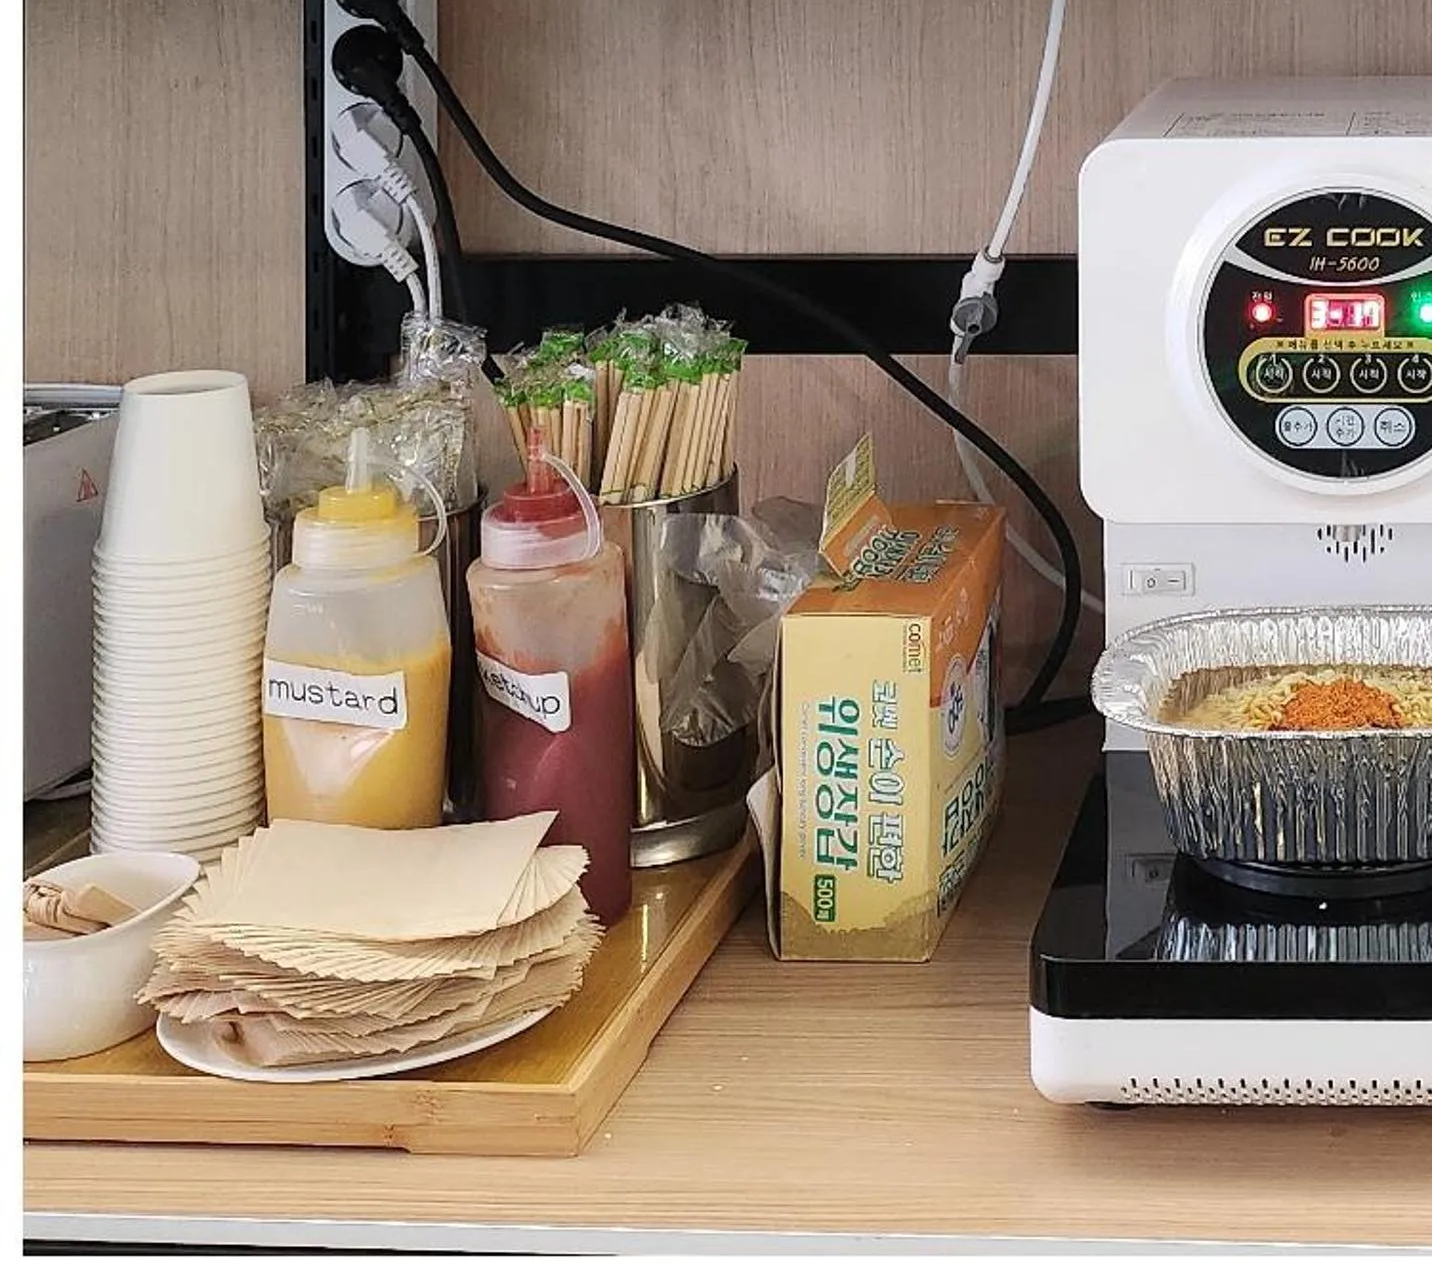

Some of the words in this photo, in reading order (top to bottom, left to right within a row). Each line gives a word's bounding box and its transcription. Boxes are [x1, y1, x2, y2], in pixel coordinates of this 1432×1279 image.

[1264, 228, 1313, 247] EZ
[1326, 228, 1425, 247] COOK
[1309, 256, 1380, 272] IH-5600
[907, 623, 922, 673] comet
[269, 677, 399, 715] mustard
[816, 695, 861, 870] 위생장갑
